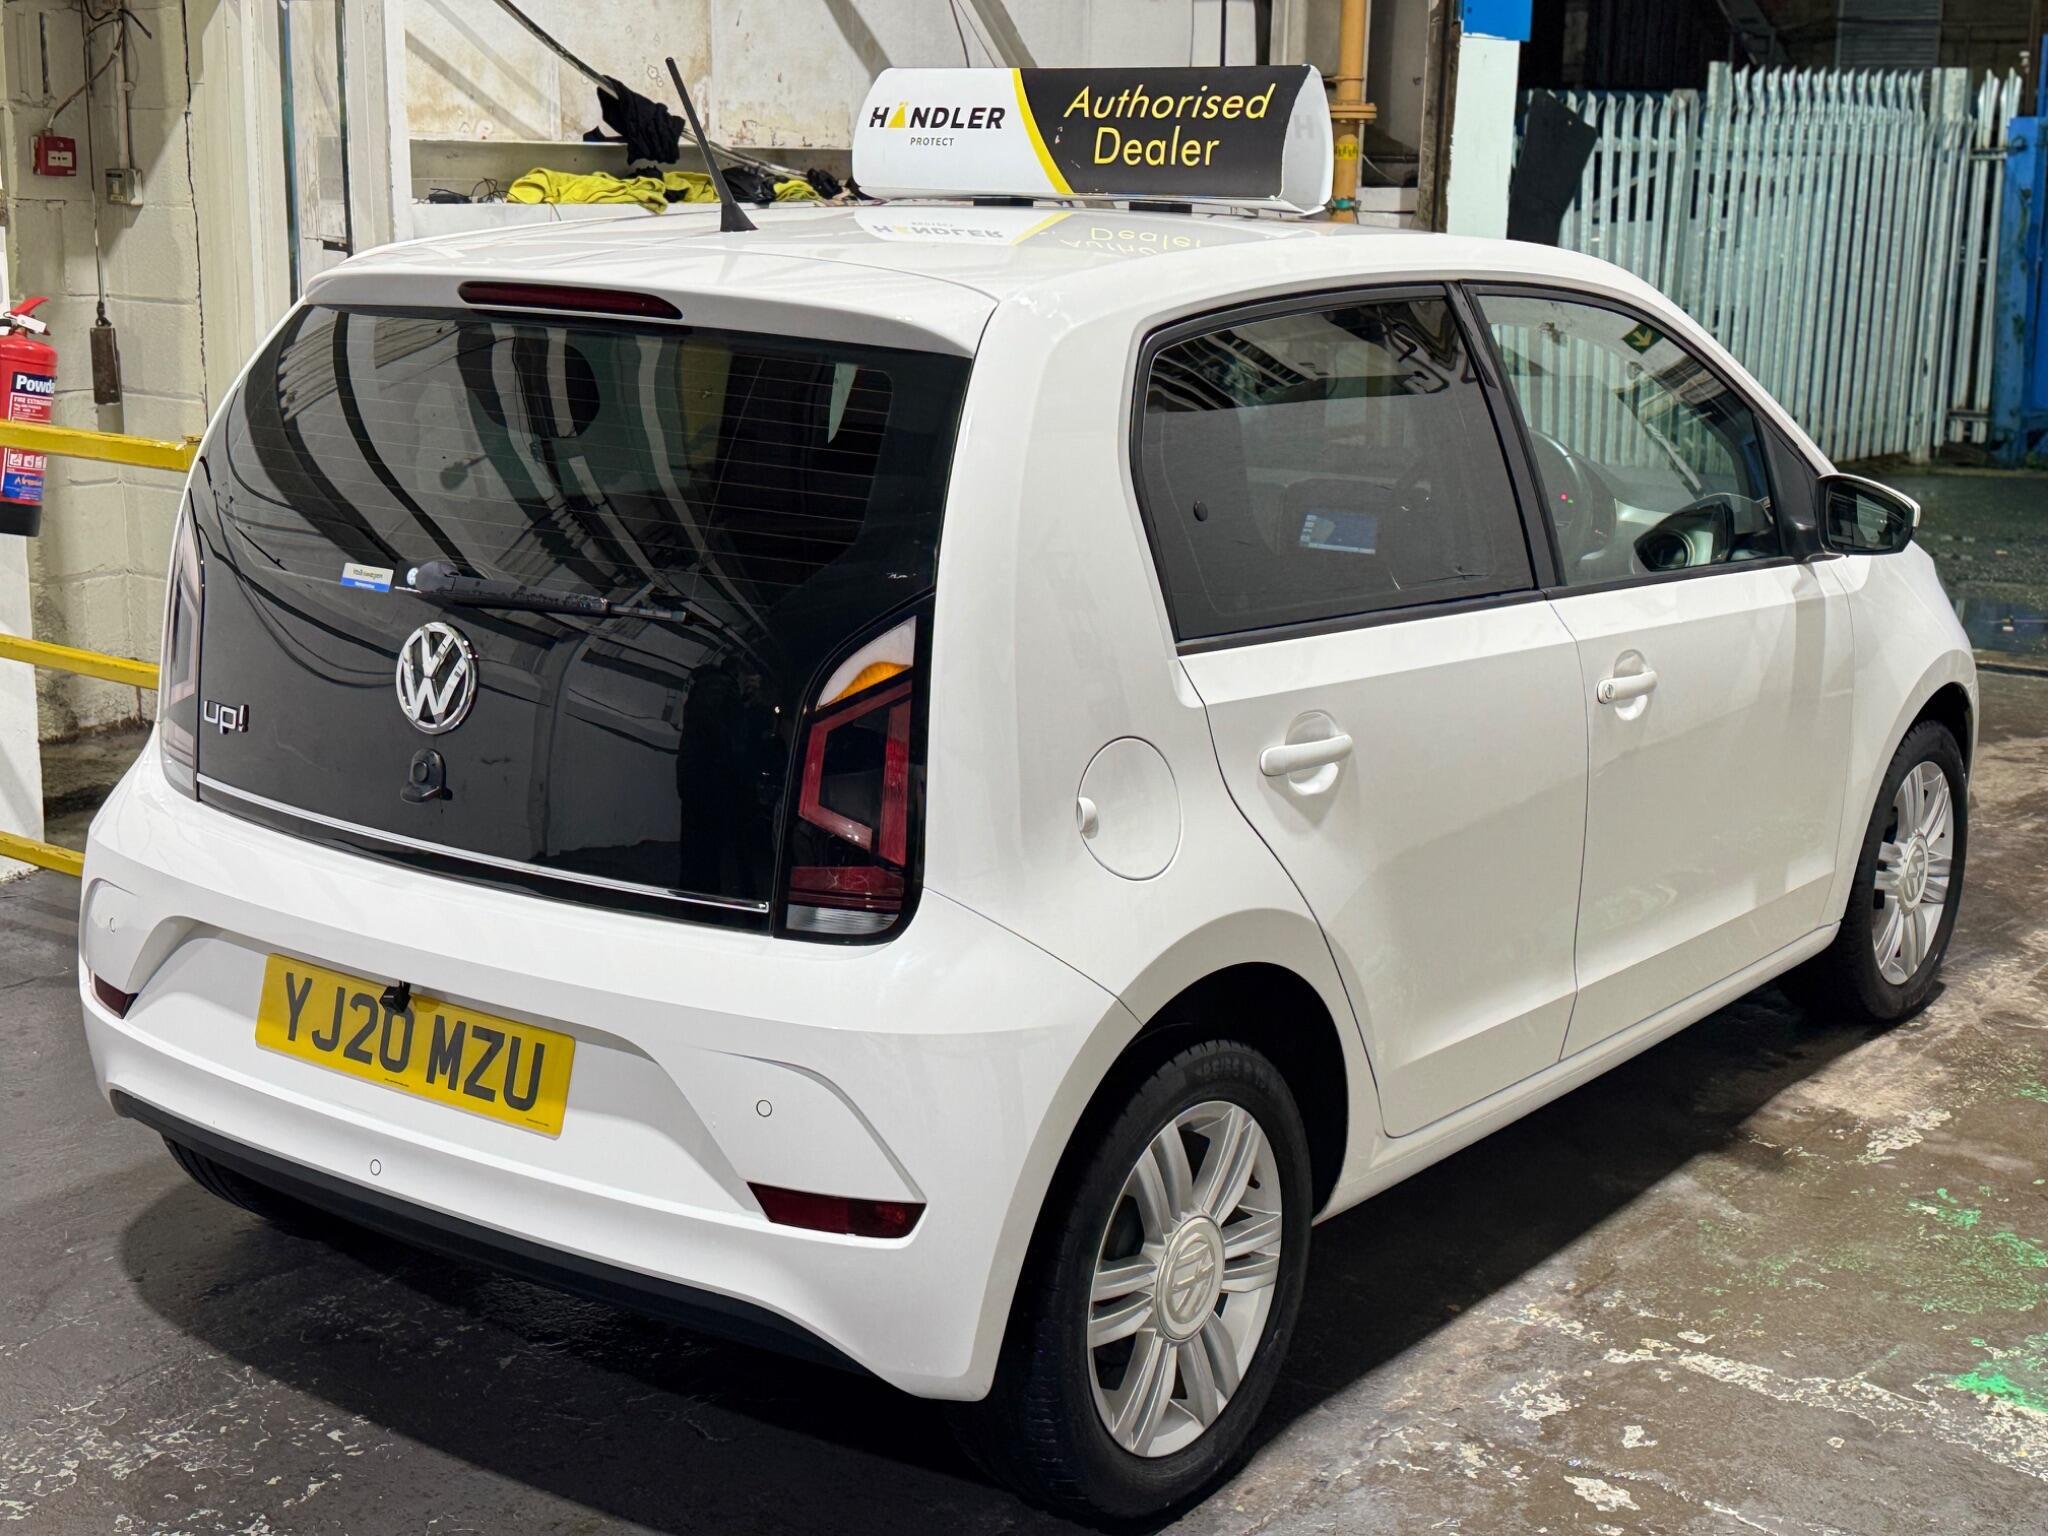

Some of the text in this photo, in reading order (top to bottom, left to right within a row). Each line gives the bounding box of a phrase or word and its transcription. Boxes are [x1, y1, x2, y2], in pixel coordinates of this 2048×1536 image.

[1063, 83, 1276, 119] Authorised
[910, 137, 954, 146] PROTECT
[1094, 125, 1220, 167] Dealer
[203, 700, 249, 735] up!
[285, 971, 546, 1112] YJ20 MZU
